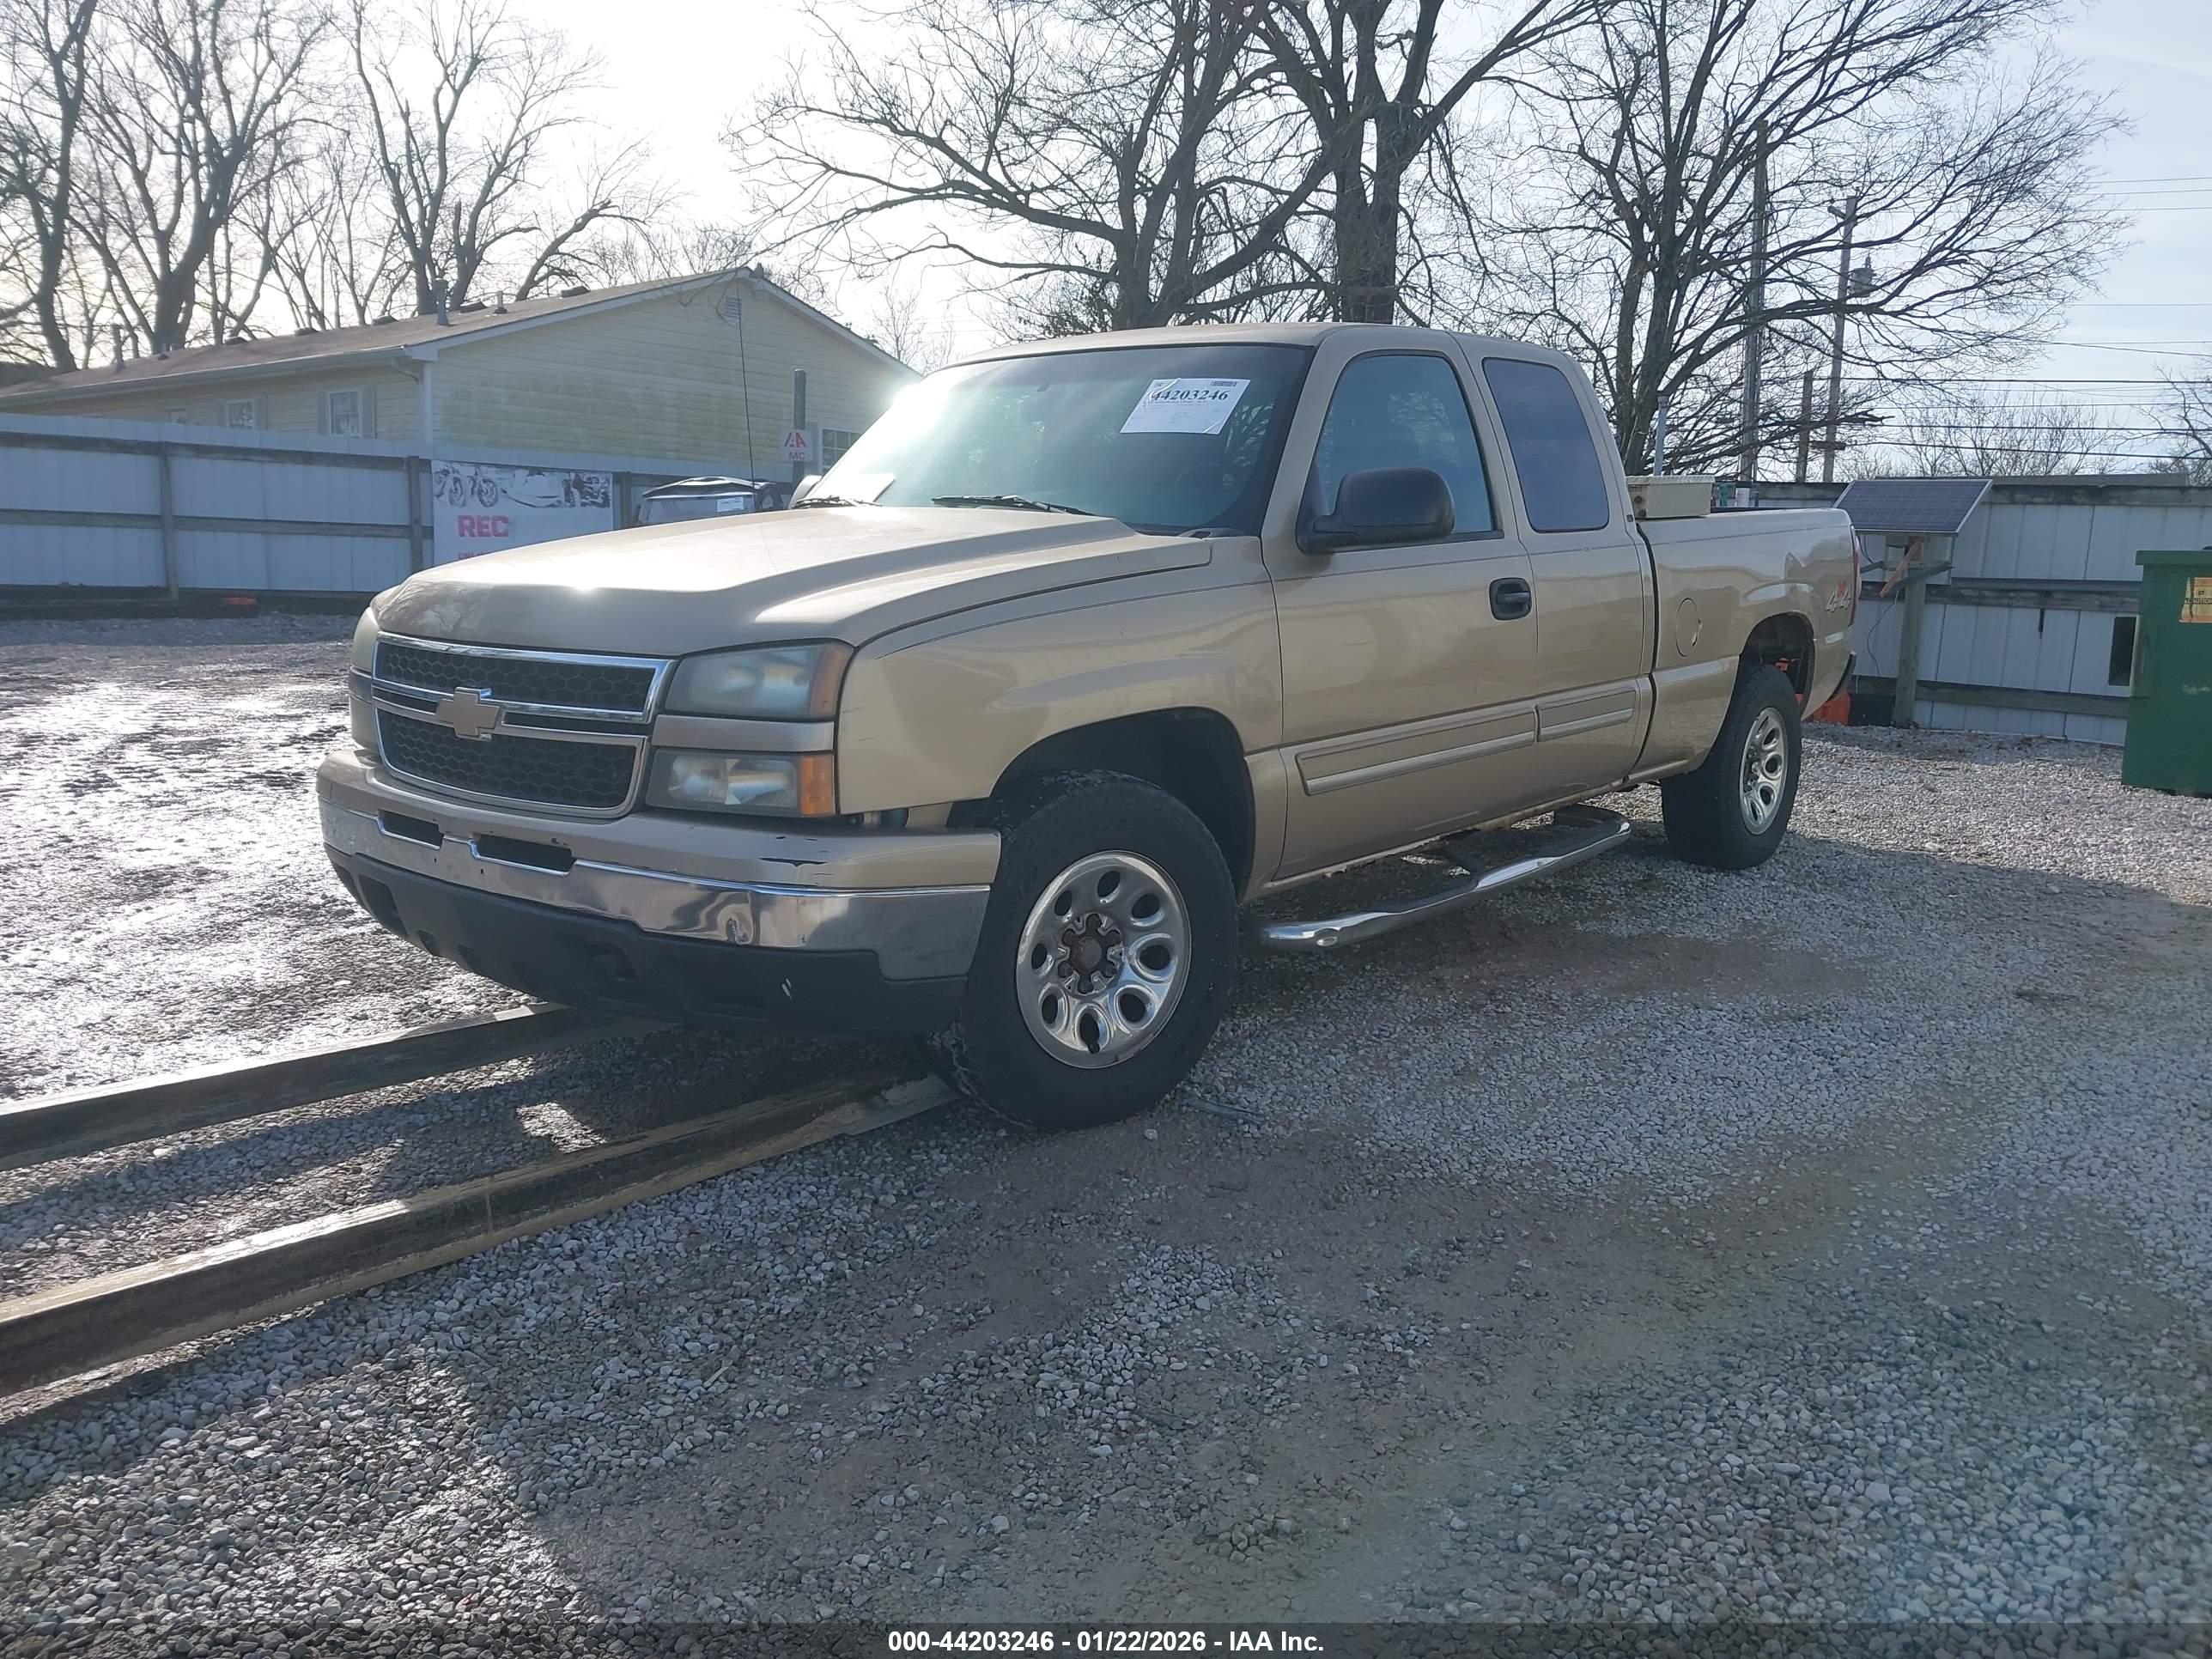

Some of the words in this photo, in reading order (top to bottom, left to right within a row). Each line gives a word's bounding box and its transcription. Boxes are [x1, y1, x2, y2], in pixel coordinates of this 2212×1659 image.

[1152, 390, 1231, 401] 44203246
[789, 452, 805, 460] MC
[458, 515, 508, 537] REC
